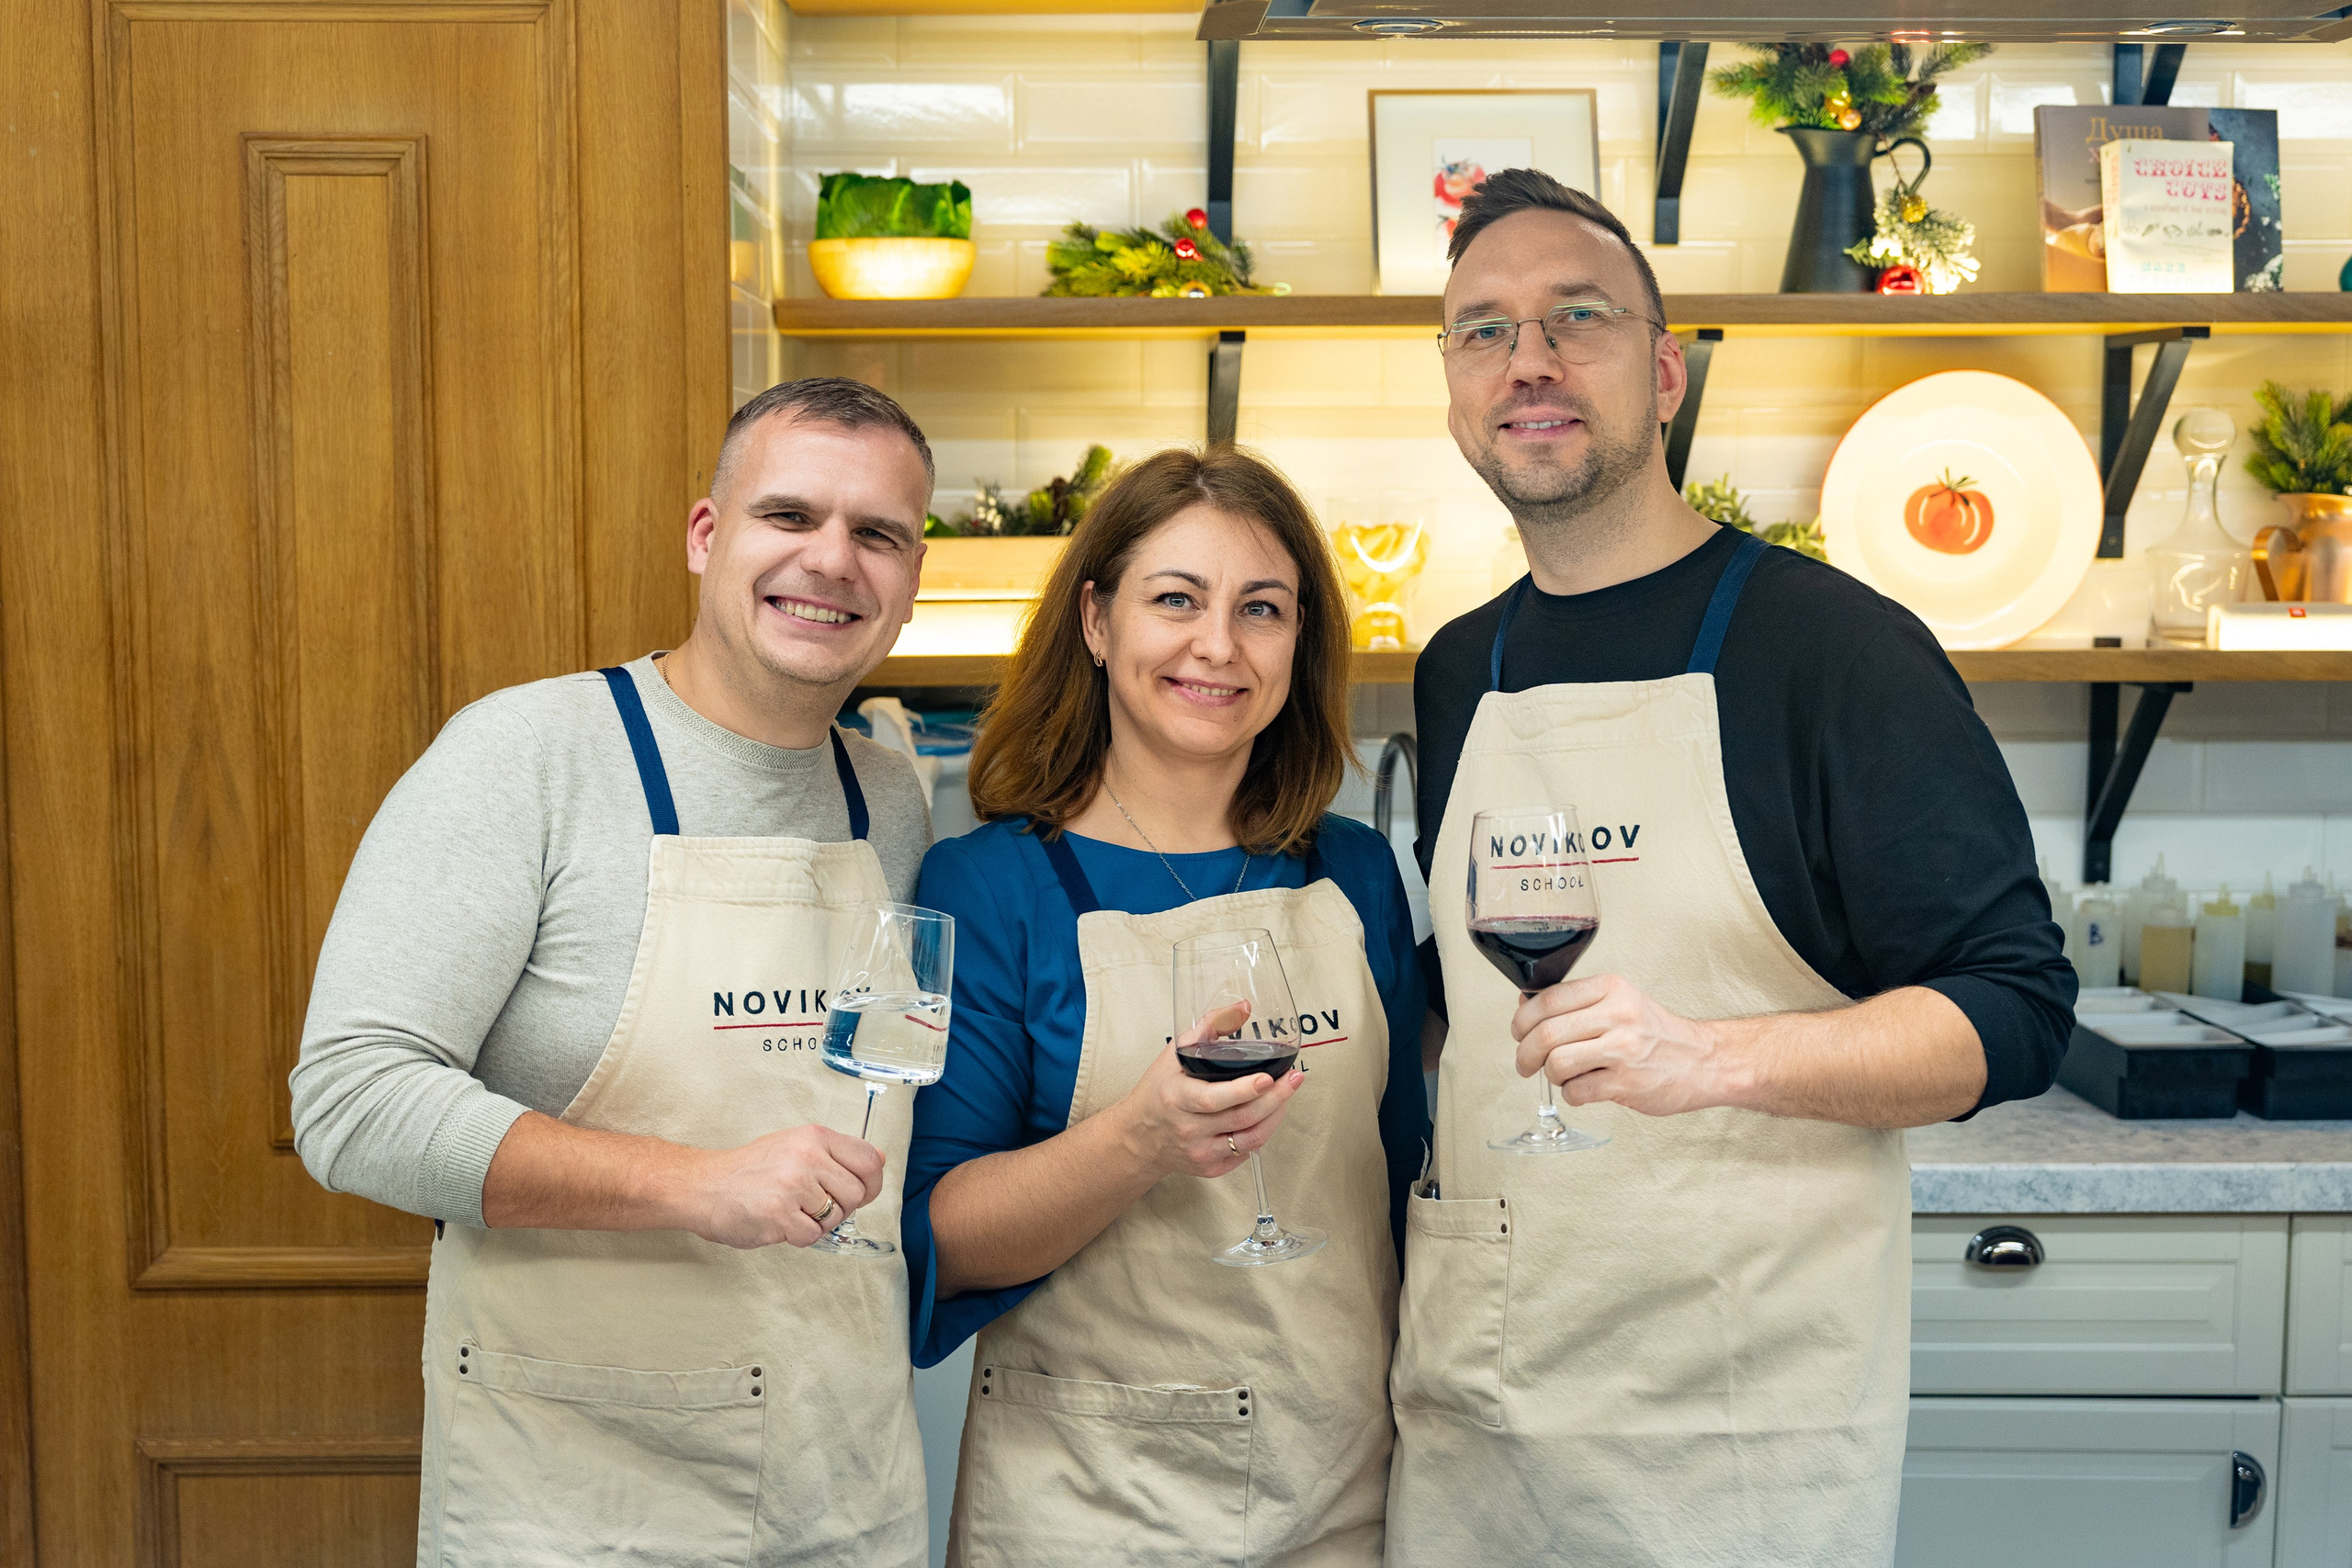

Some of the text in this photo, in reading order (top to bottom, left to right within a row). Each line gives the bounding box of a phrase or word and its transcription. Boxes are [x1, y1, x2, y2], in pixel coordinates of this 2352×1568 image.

[2133, 157, 2227, 178] CHOICE
[2165, 179, 2227, 201] CUTS
[1490, 825, 1641, 858] NOVIKOV
[1520, 876, 1585, 891] SCHOOL
[713, 987, 872, 1017] NOVIK
[762, 1037, 818, 1053] SCHO
